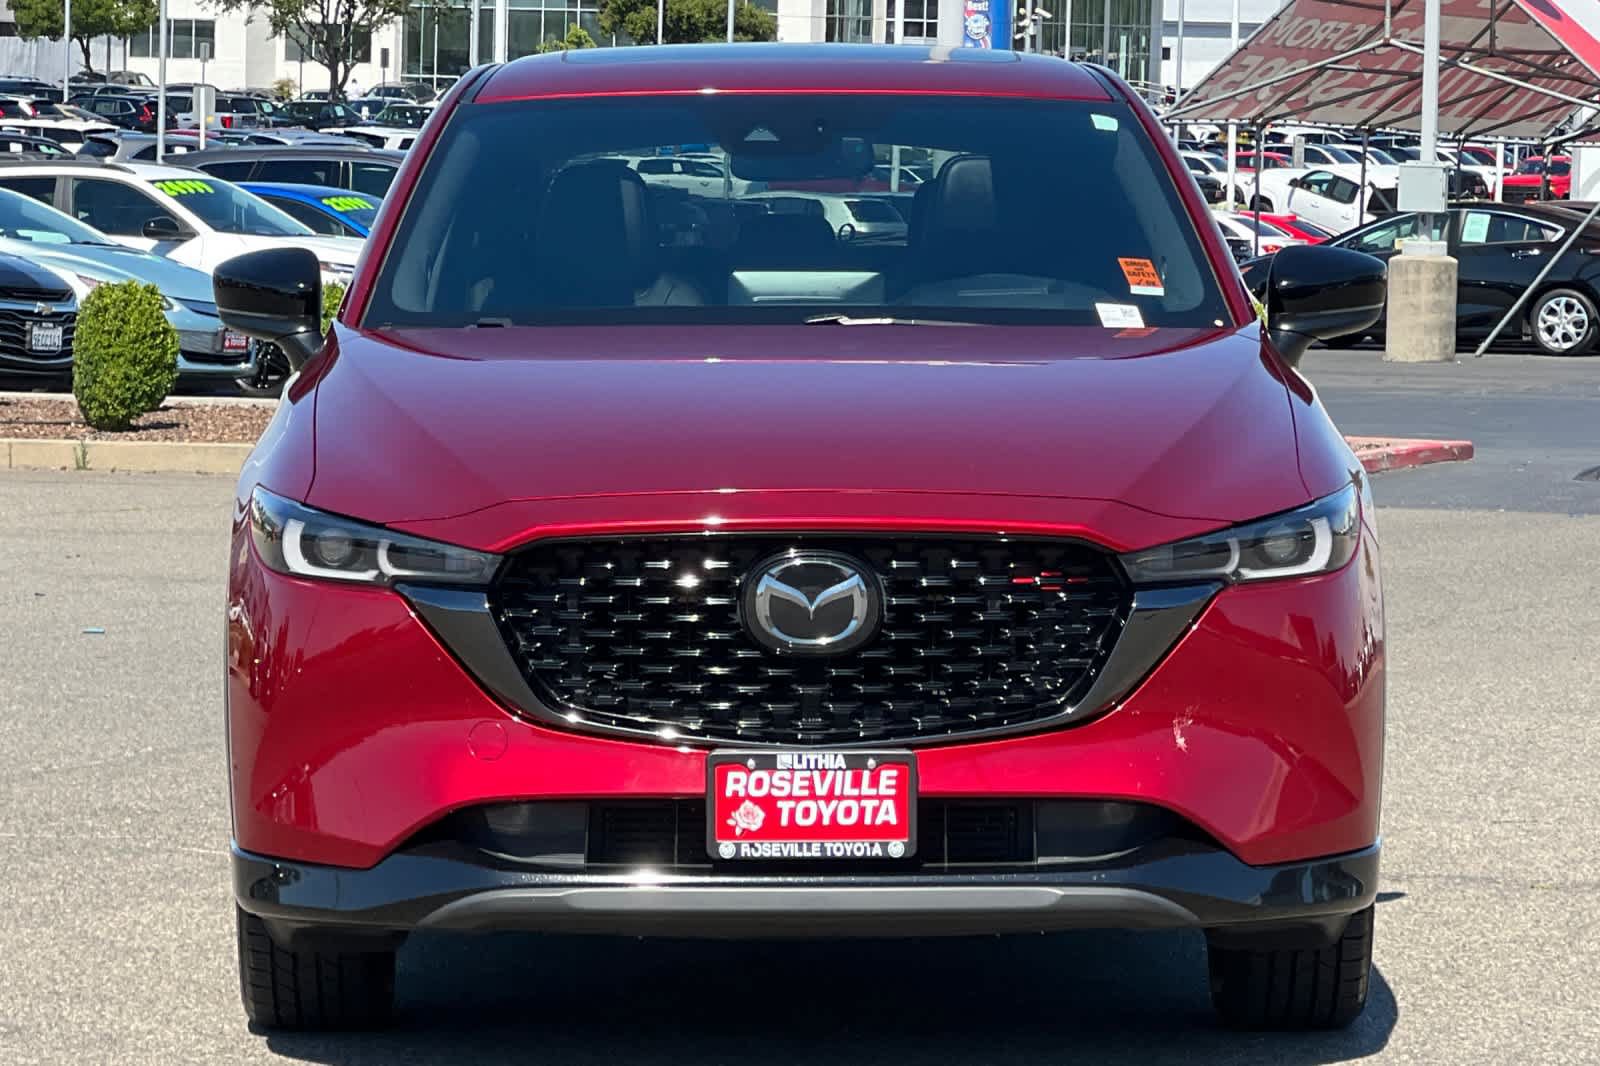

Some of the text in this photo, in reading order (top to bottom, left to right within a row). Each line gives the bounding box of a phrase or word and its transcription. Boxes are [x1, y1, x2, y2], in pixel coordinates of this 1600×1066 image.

[793, 754, 847, 769] LITHIA
[725, 770, 897, 798] ROSEVILLE
[777, 799, 897, 827] TOYOTA
[741, 843, 882, 857] ROSEVILLE TOYOTA
